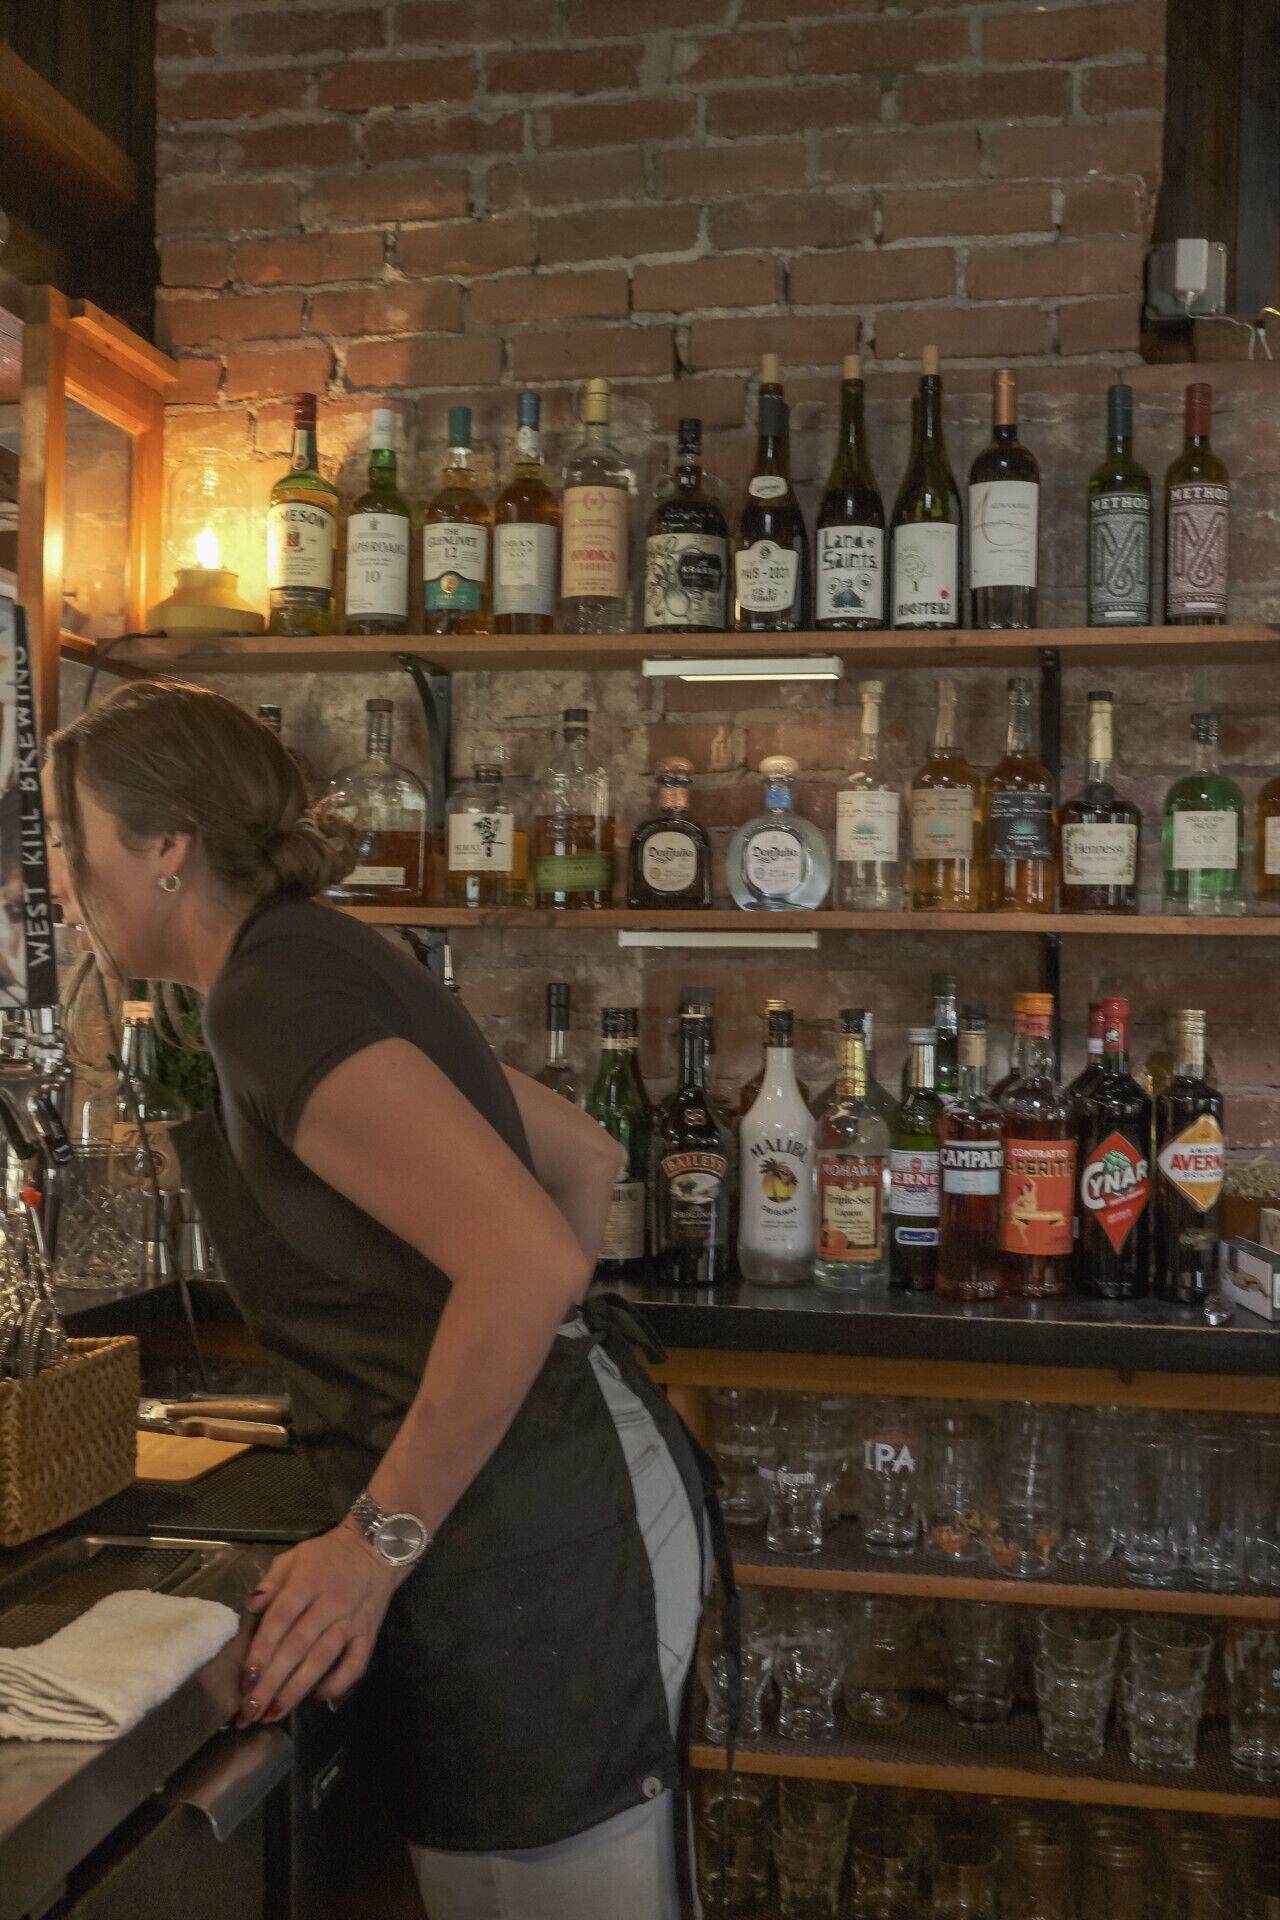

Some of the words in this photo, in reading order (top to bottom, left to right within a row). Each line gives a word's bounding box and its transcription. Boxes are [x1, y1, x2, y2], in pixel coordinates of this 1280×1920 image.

[823, 530, 865, 550] Land
[822, 550, 878, 568] Saints
[20, 807, 45, 866] KILL
[24, 887, 52, 967] WEST
[666, 1154, 724, 1173] BAILEYS
[939, 1148, 1005, 1168] CAMPARI
[1170, 1154, 1223, 1171] AVERN
[822, 1163, 879, 1177] MOHAWK
[1081, 1159, 1149, 1210] CYNAR
[863, 1439, 916, 1473] IPA
